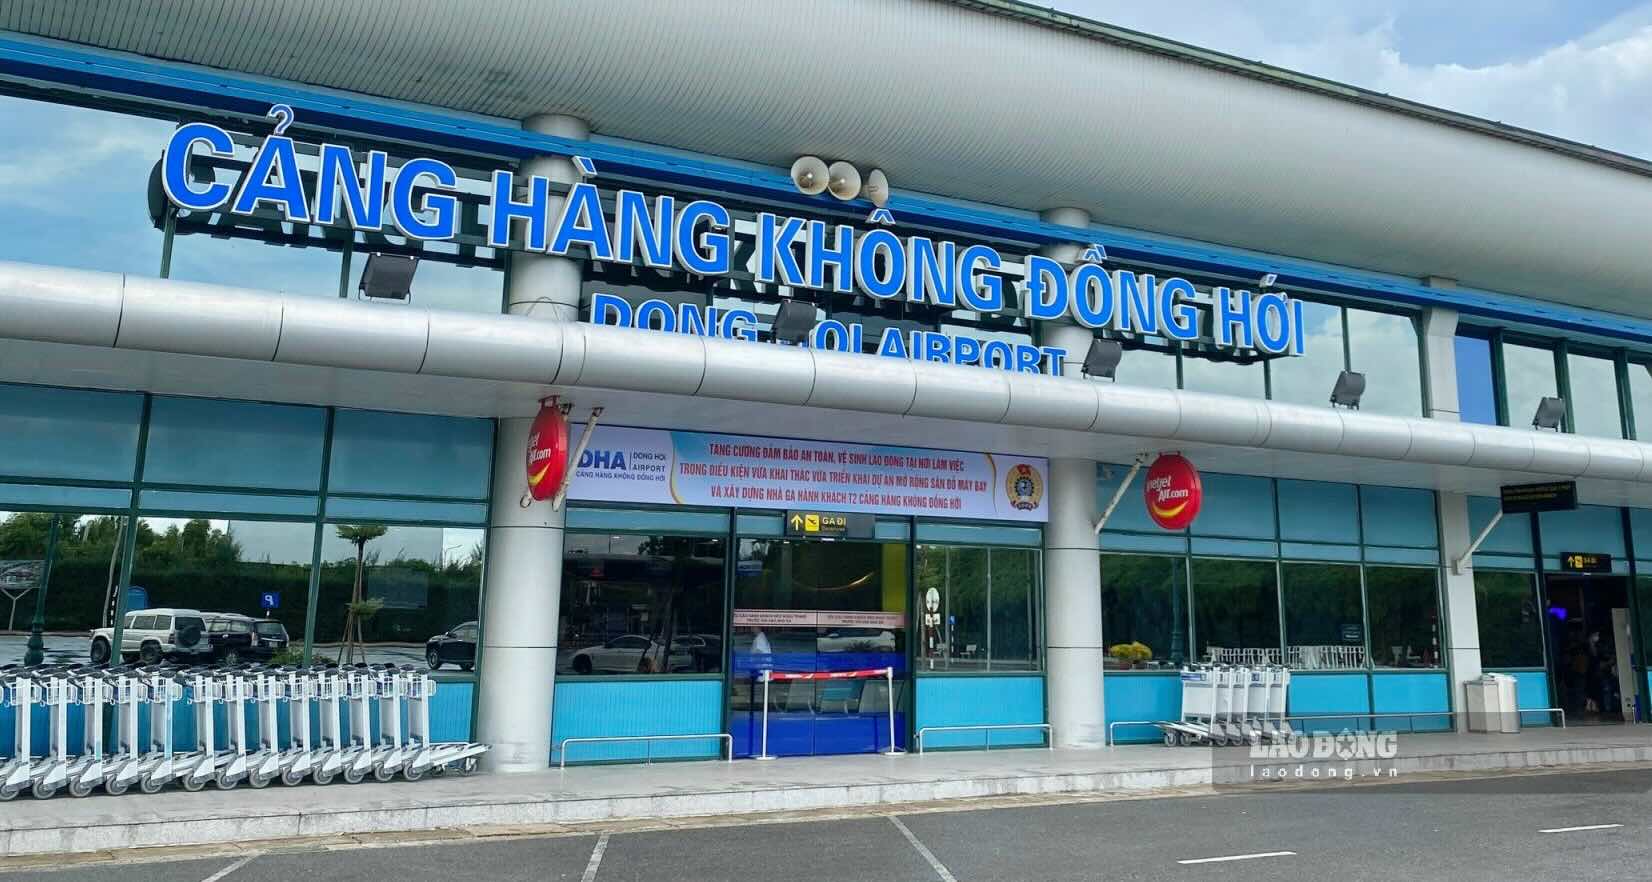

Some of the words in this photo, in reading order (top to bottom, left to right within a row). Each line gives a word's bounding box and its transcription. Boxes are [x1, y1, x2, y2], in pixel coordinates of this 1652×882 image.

[162, 103, 462, 241] CẢNG
[487, 155, 731, 275] HÀNG
[755, 208, 1003, 312] KHÔNG
[1024, 243, 1199, 341] ĐỒNG
[1212, 273, 1305, 356] HỚI
[590, 292, 758, 345] DONG
[777, 319, 864, 354] OI
[877, 327, 1068, 377] AIRPORT
[577, 449, 627, 471] DHA
[632, 463, 666, 473] AIRPORT
[709, 443, 731, 457] TĂNG
[783, 445, 799, 461] BẢO
[801, 449, 812, 462] AN
[849, 452, 867, 465] SINH
[869, 454, 882, 466] LAO
[950, 458, 965, 472] VIỆC
[680, 462, 707, 475] TRONG
[769, 467, 788, 481] KHAI
[852, 471, 870, 485] KHAI
[711, 484, 722, 498] VÀ
[723, 484, 740, 499] XÂY
[742, 487, 765, 502] DỰNG
[766, 487, 783, 501] NHÀ
[785, 489, 796, 501] GA
[848, 492, 857, 505] T2
[822, 516, 836, 526] GA
[836, 517, 847, 527] ĐI
